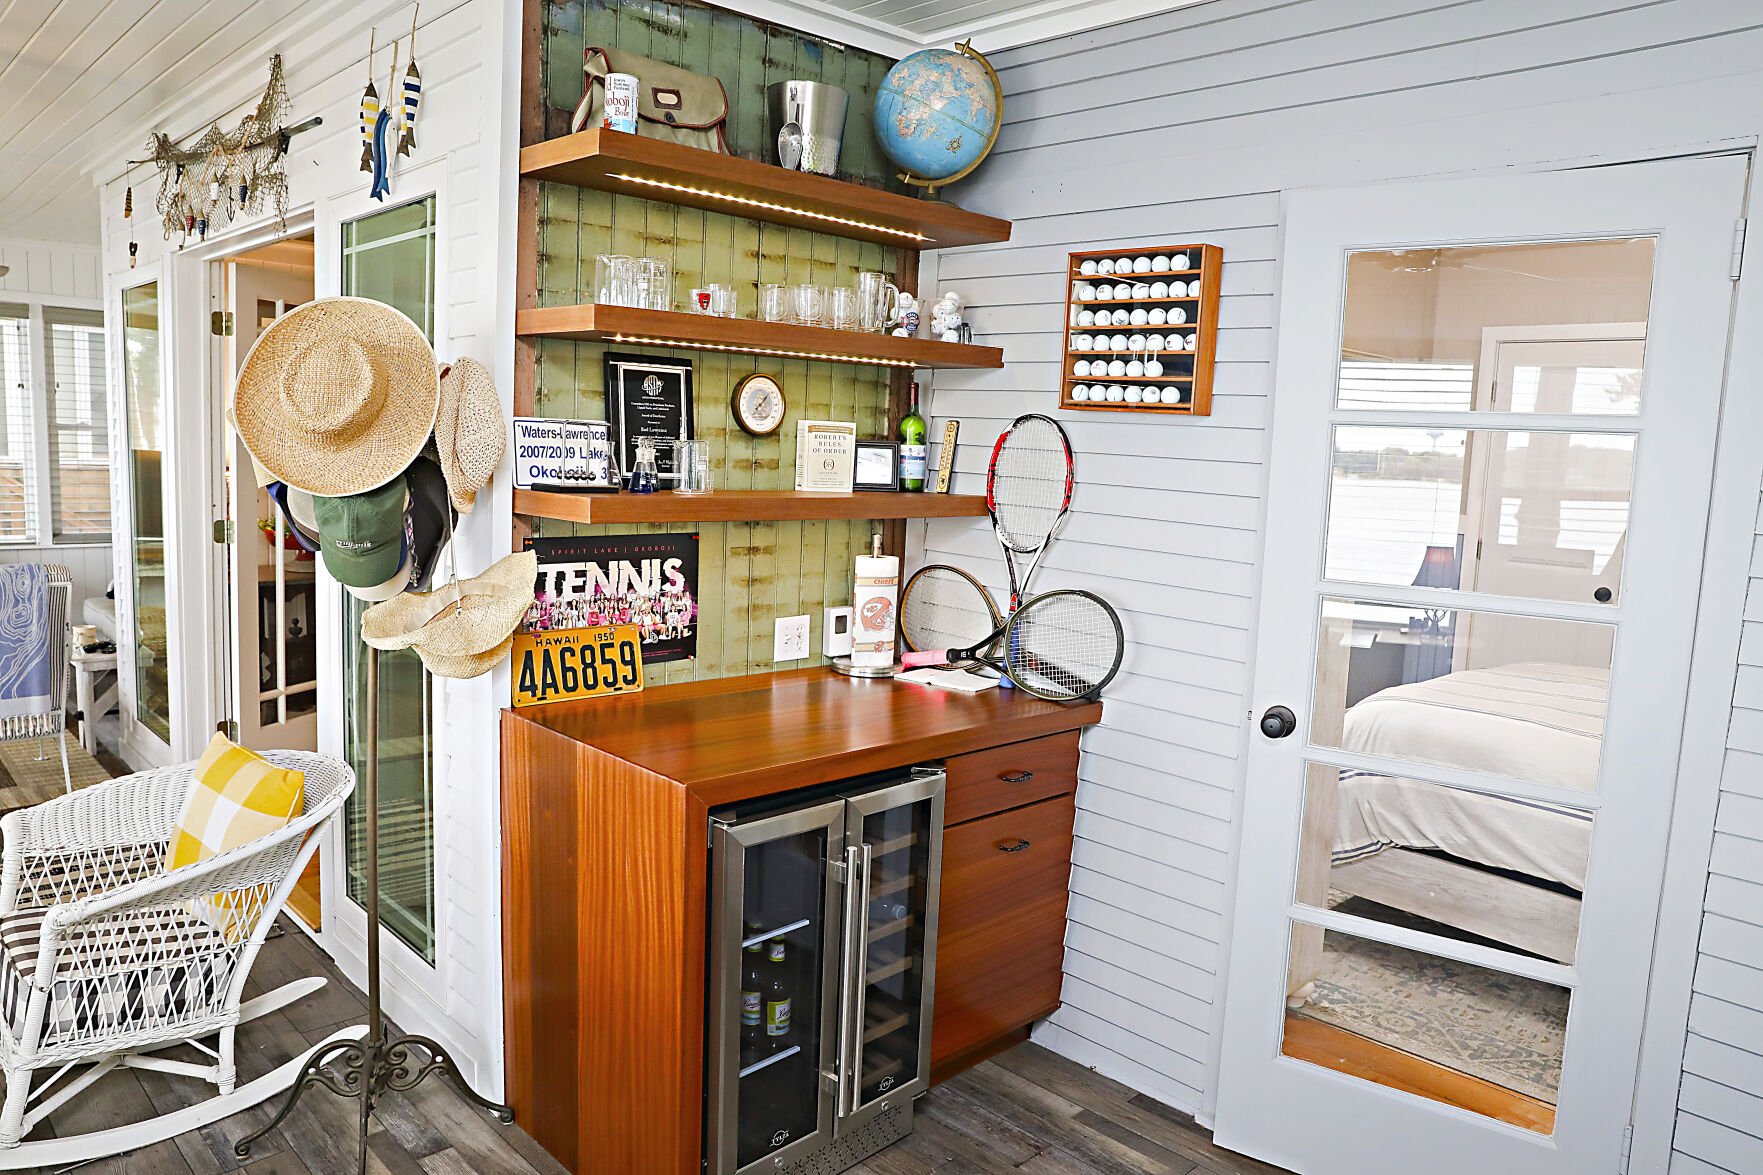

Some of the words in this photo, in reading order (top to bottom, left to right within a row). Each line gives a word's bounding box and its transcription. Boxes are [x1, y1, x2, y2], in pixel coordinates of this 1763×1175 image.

[551, 548, 588, 556] SPIRIT
[536, 558, 685, 602] TENNIS
[535, 635, 579, 647] HAWAII
[593, 632, 615, 642] 1950
[519, 640, 638, 698] 4A6859
